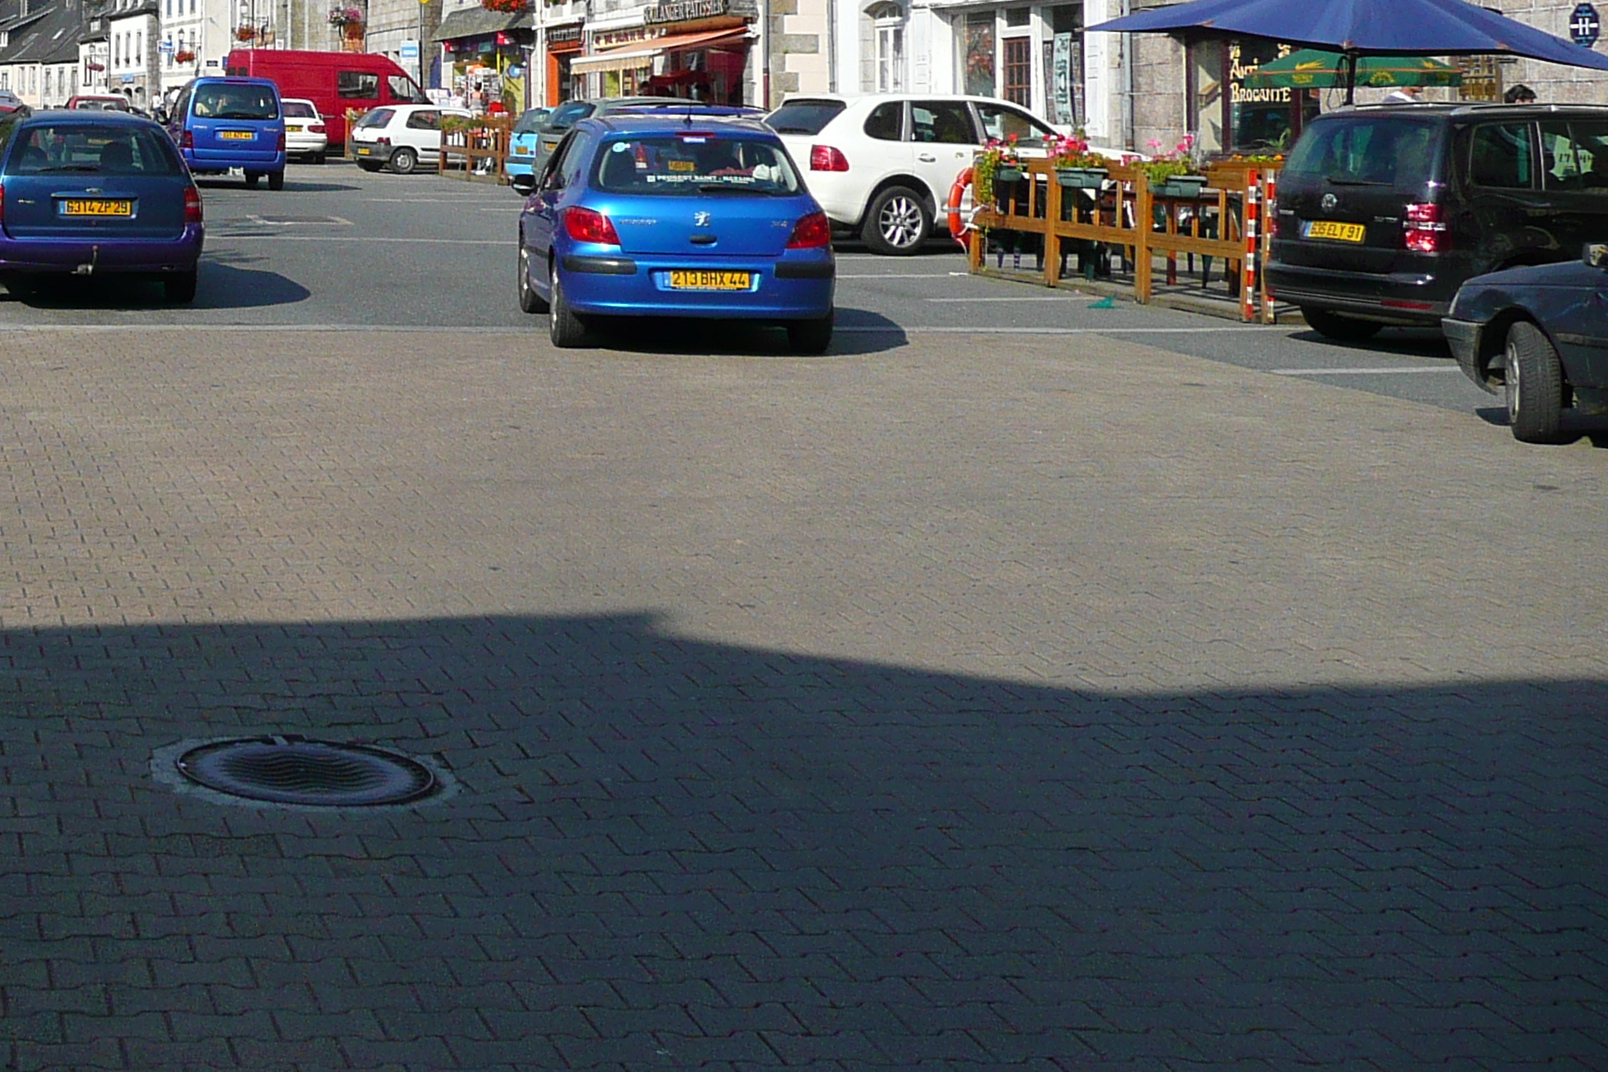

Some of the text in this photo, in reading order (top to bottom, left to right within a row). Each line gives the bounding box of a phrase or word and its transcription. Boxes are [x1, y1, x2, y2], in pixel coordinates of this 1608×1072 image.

[1578, 17, 1590, 36] H
[1229, 82, 1292, 103] BROCANTE
[66, 200, 128, 213] 6314 ZP 29
[1346, 225, 1361, 239] 91
[672, 271, 746, 286] 213 BHX 44
